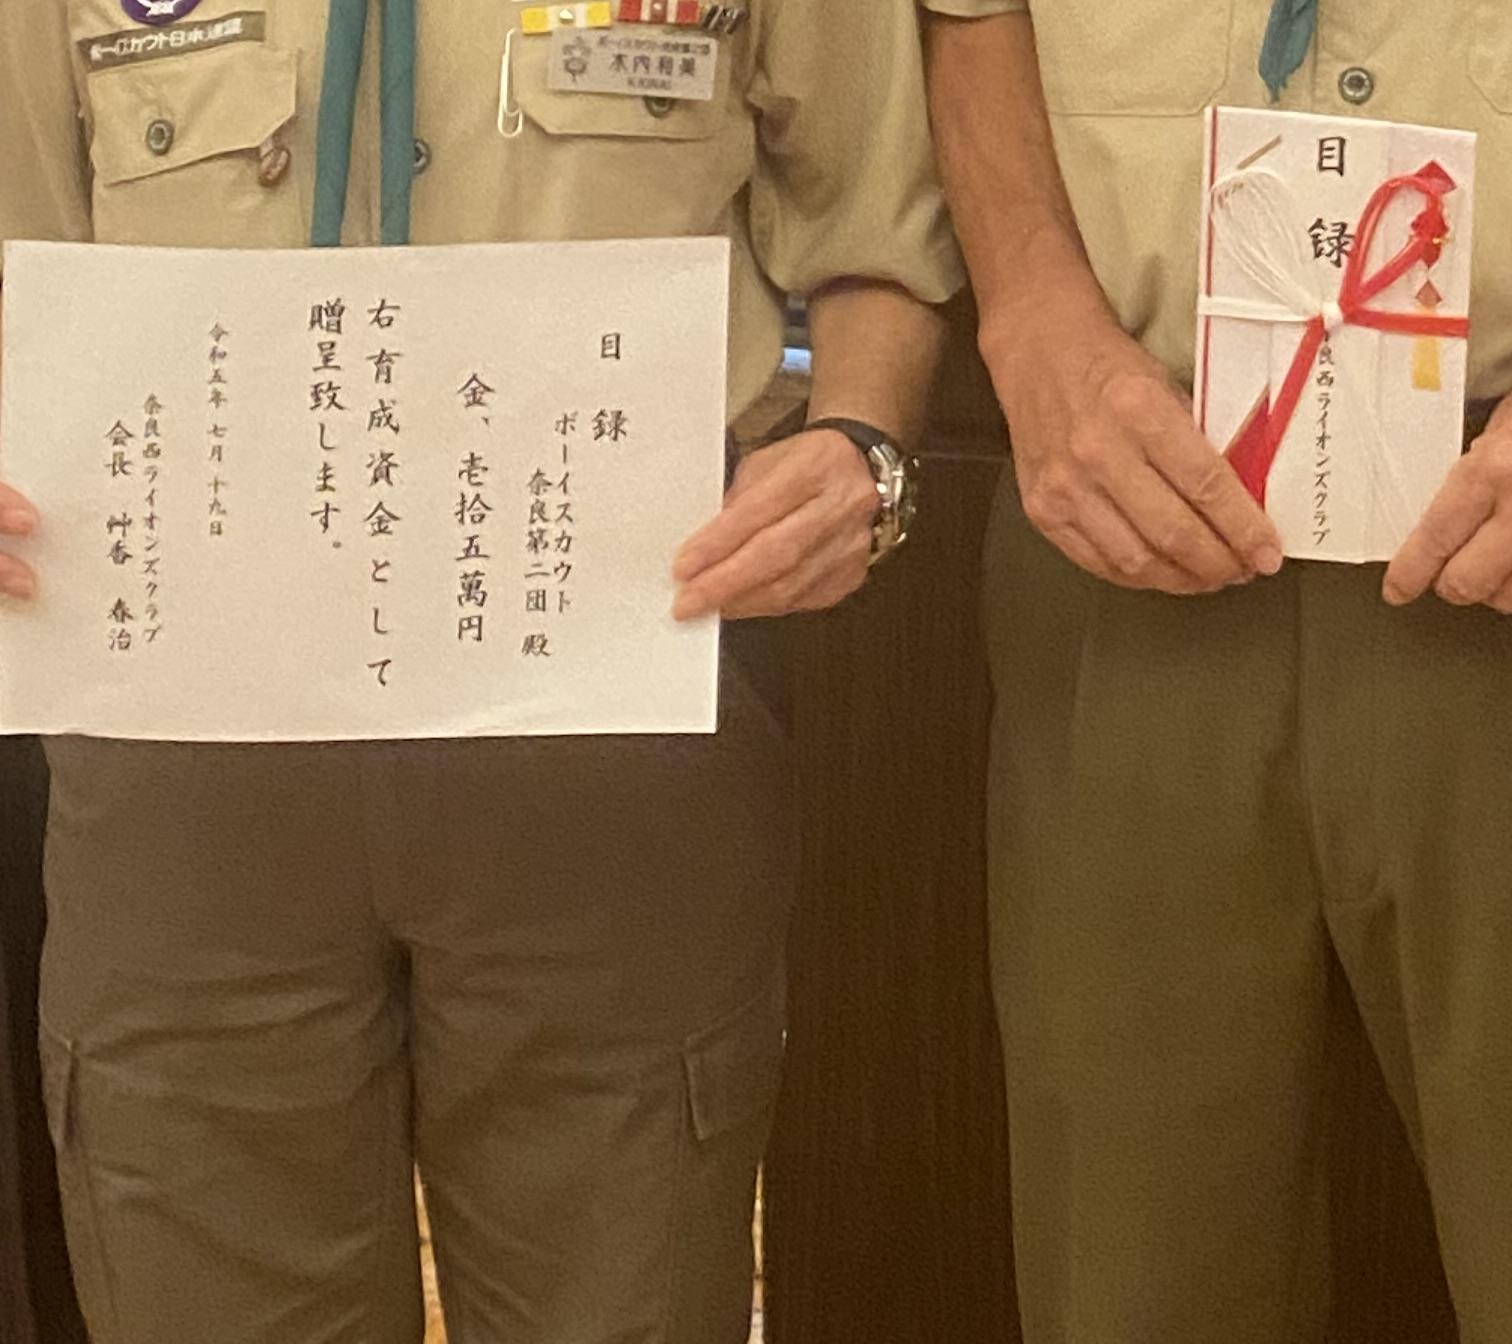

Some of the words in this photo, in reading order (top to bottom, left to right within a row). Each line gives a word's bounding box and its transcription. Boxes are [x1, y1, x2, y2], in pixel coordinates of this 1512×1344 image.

[1307, 135, 1355, 269] 目録
[362, 297, 402, 687] 右育成資金として
[591, 331, 629, 443] 目録
[1312, 328, 1335, 546] 良西ライオンズクラブ
[142, 392, 164, 644] 奈良西ライオンズクラブ
[554, 411, 579, 614] ボーイスカウト
